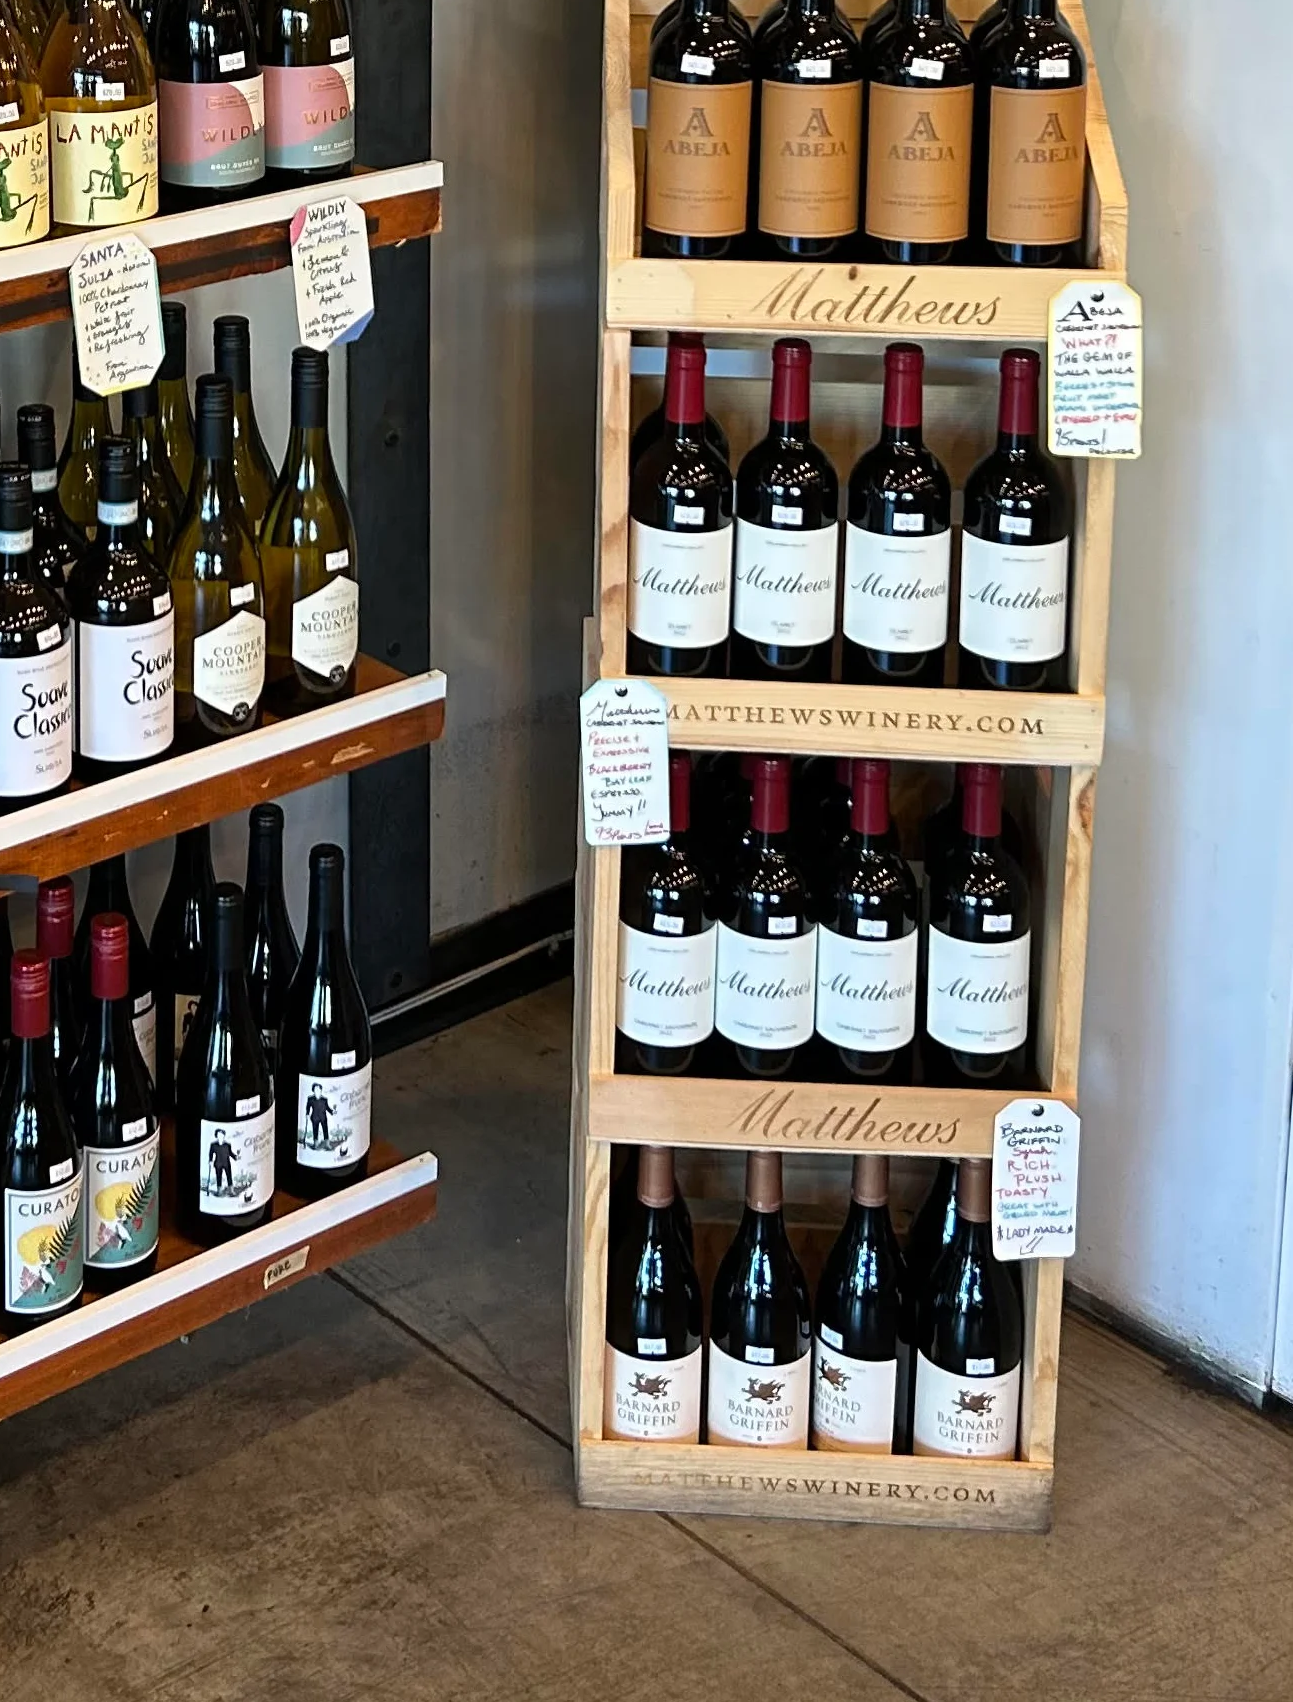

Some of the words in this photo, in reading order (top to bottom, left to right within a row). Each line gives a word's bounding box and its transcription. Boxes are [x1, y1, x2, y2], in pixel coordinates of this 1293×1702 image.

[56, 120, 81, 144] LA
[90, 114, 154, 143] MANTIS
[662, 138, 731, 158] ABEJA
[779, 139, 848, 158] ABEJA
[887, 145, 956, 163] ABEJA
[1014, 145, 1079, 165] ABEJA
[308, 200, 346, 222] WILDLY
[80, 242, 124, 269] SANTA
[79, 270, 113, 289] JULIA
[751, 267, 1002, 326] Matthews
[1062, 337, 1101, 349] WHAT
[1055, 352, 1078, 366] THE
[1083, 352, 1112, 362] GEM
[1117, 351, 1133, 361] OF
[664, 704, 1045, 735] MATTHEWSWINERY.COM
[728, 1088, 962, 1146] Matthews
[1001, 1123, 1064, 1139] BARNARD
[1007, 1136, 1060, 1147] GRIFFIN
[1007, 1160, 1050, 1172] RICH
[1014, 1173, 1062, 1187] PLUSH
[995, 1187, 1048, 1199] TOASTY
[1006, 1225, 1030, 1240] LADY
[1034, 1224, 1066, 1235] MADE
[616, 1392, 681, 1415] BARNARD
[727, 1398, 794, 1420] BARNARD
[617, 1408, 677, 1427] GRIFFIN
[729, 1413, 790, 1432] GRIFFIN
[936, 1411, 1004, 1431] BARNARD
[938, 1425, 1001, 1444] GRIFFIN
[632, 1472, 996, 1504] MATTHEWSWINERY.COM
